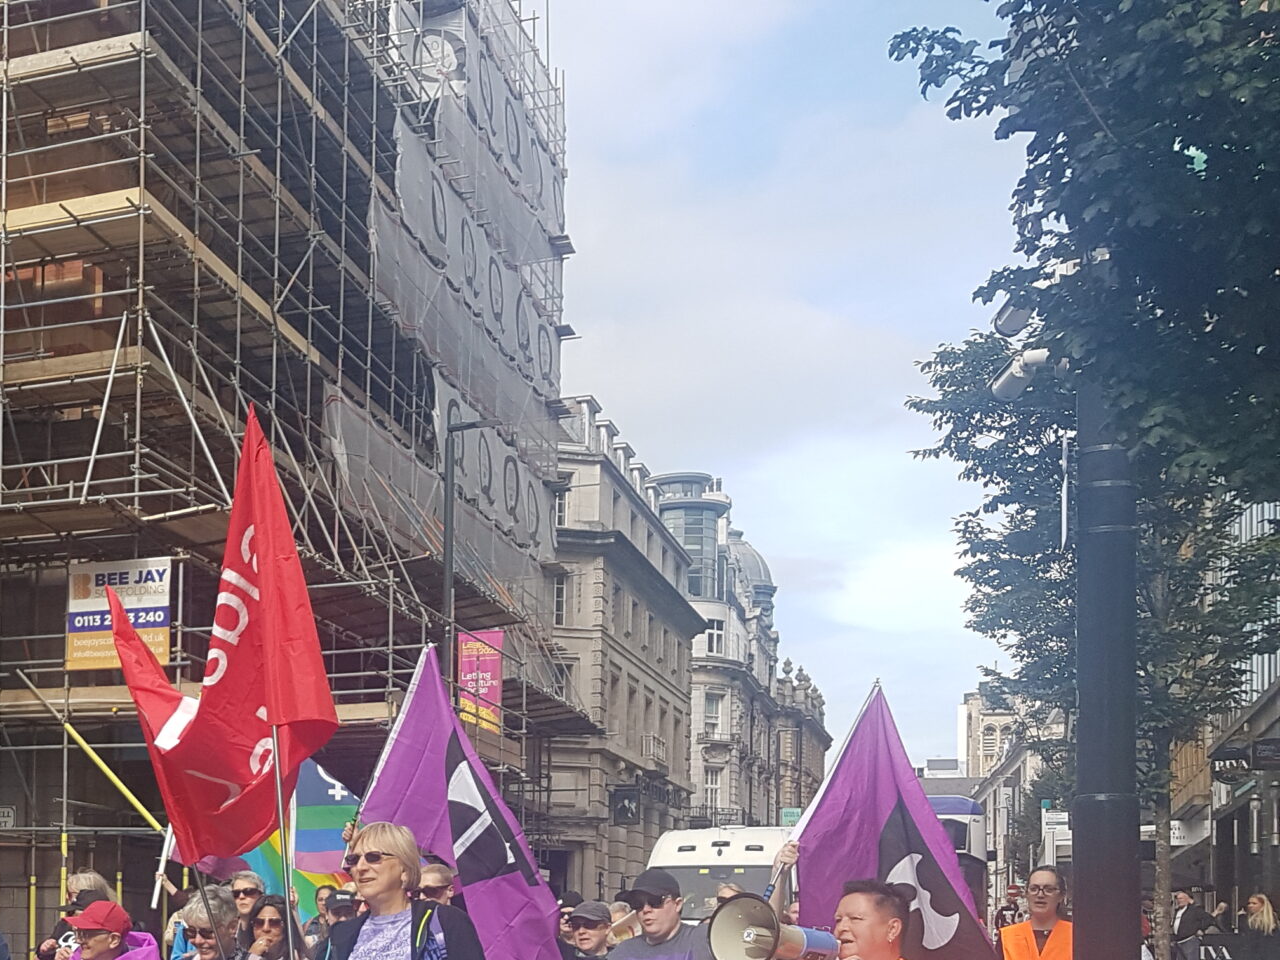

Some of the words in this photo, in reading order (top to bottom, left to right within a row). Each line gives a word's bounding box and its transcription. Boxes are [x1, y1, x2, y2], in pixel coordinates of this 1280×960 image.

[95, 571, 130, 587] BEE
[134, 568, 168, 584] JAY
[95, 585, 165, 599] SCFFOLDING
[74, 614, 101, 628] 0113
[103, 613, 135, 626] 23
[137, 610, 165, 623] 240
[461, 672, 491, 680] Lettng
[467, 679, 499, 688] cuture
